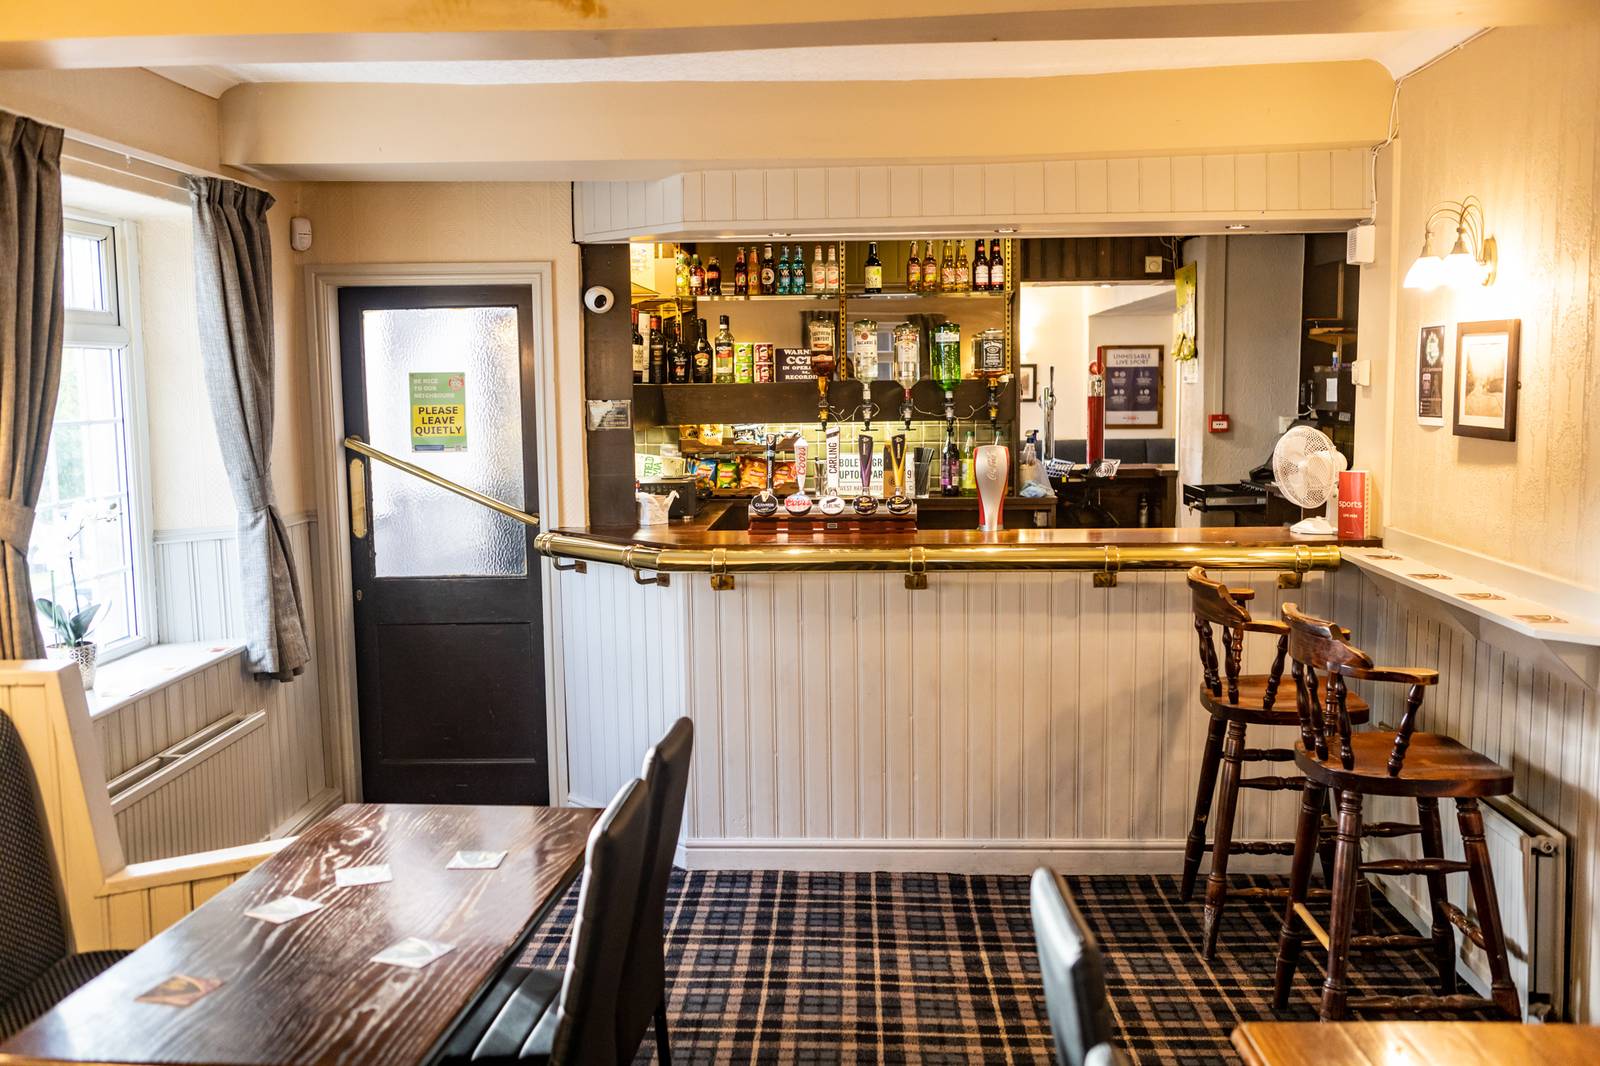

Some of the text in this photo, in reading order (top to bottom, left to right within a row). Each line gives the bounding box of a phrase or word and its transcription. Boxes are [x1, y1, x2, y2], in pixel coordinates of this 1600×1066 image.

[786, 356, 811, 364] CCT
[418, 406, 459, 415] PLEASE
[421, 416, 455, 425] LEAVE
[415, 426, 462, 436] QUIETLY
[828, 442, 838, 474] CARLING
[839, 458, 859, 467] BOLE
[839, 470, 860, 479] UPTO
[1338, 500, 1363, 508] sports
